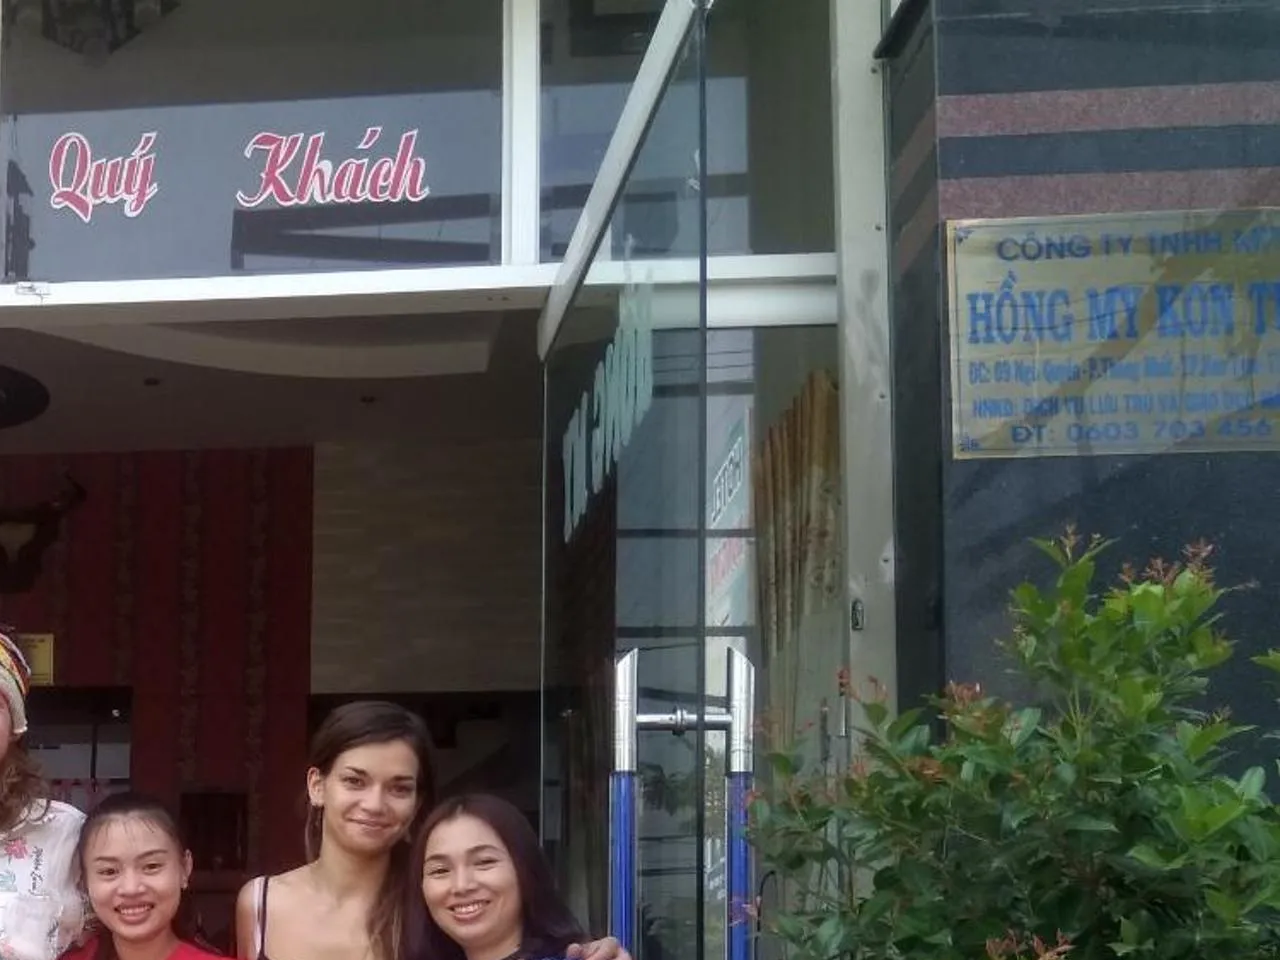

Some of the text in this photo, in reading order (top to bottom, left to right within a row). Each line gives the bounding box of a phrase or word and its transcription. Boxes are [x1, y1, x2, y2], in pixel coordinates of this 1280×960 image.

[48, 130, 160, 223] Quý
[235, 126, 430, 210] Khách
[996, 232, 1092, 261] CÔNG
[966, 270, 1075, 344] HỒNG
